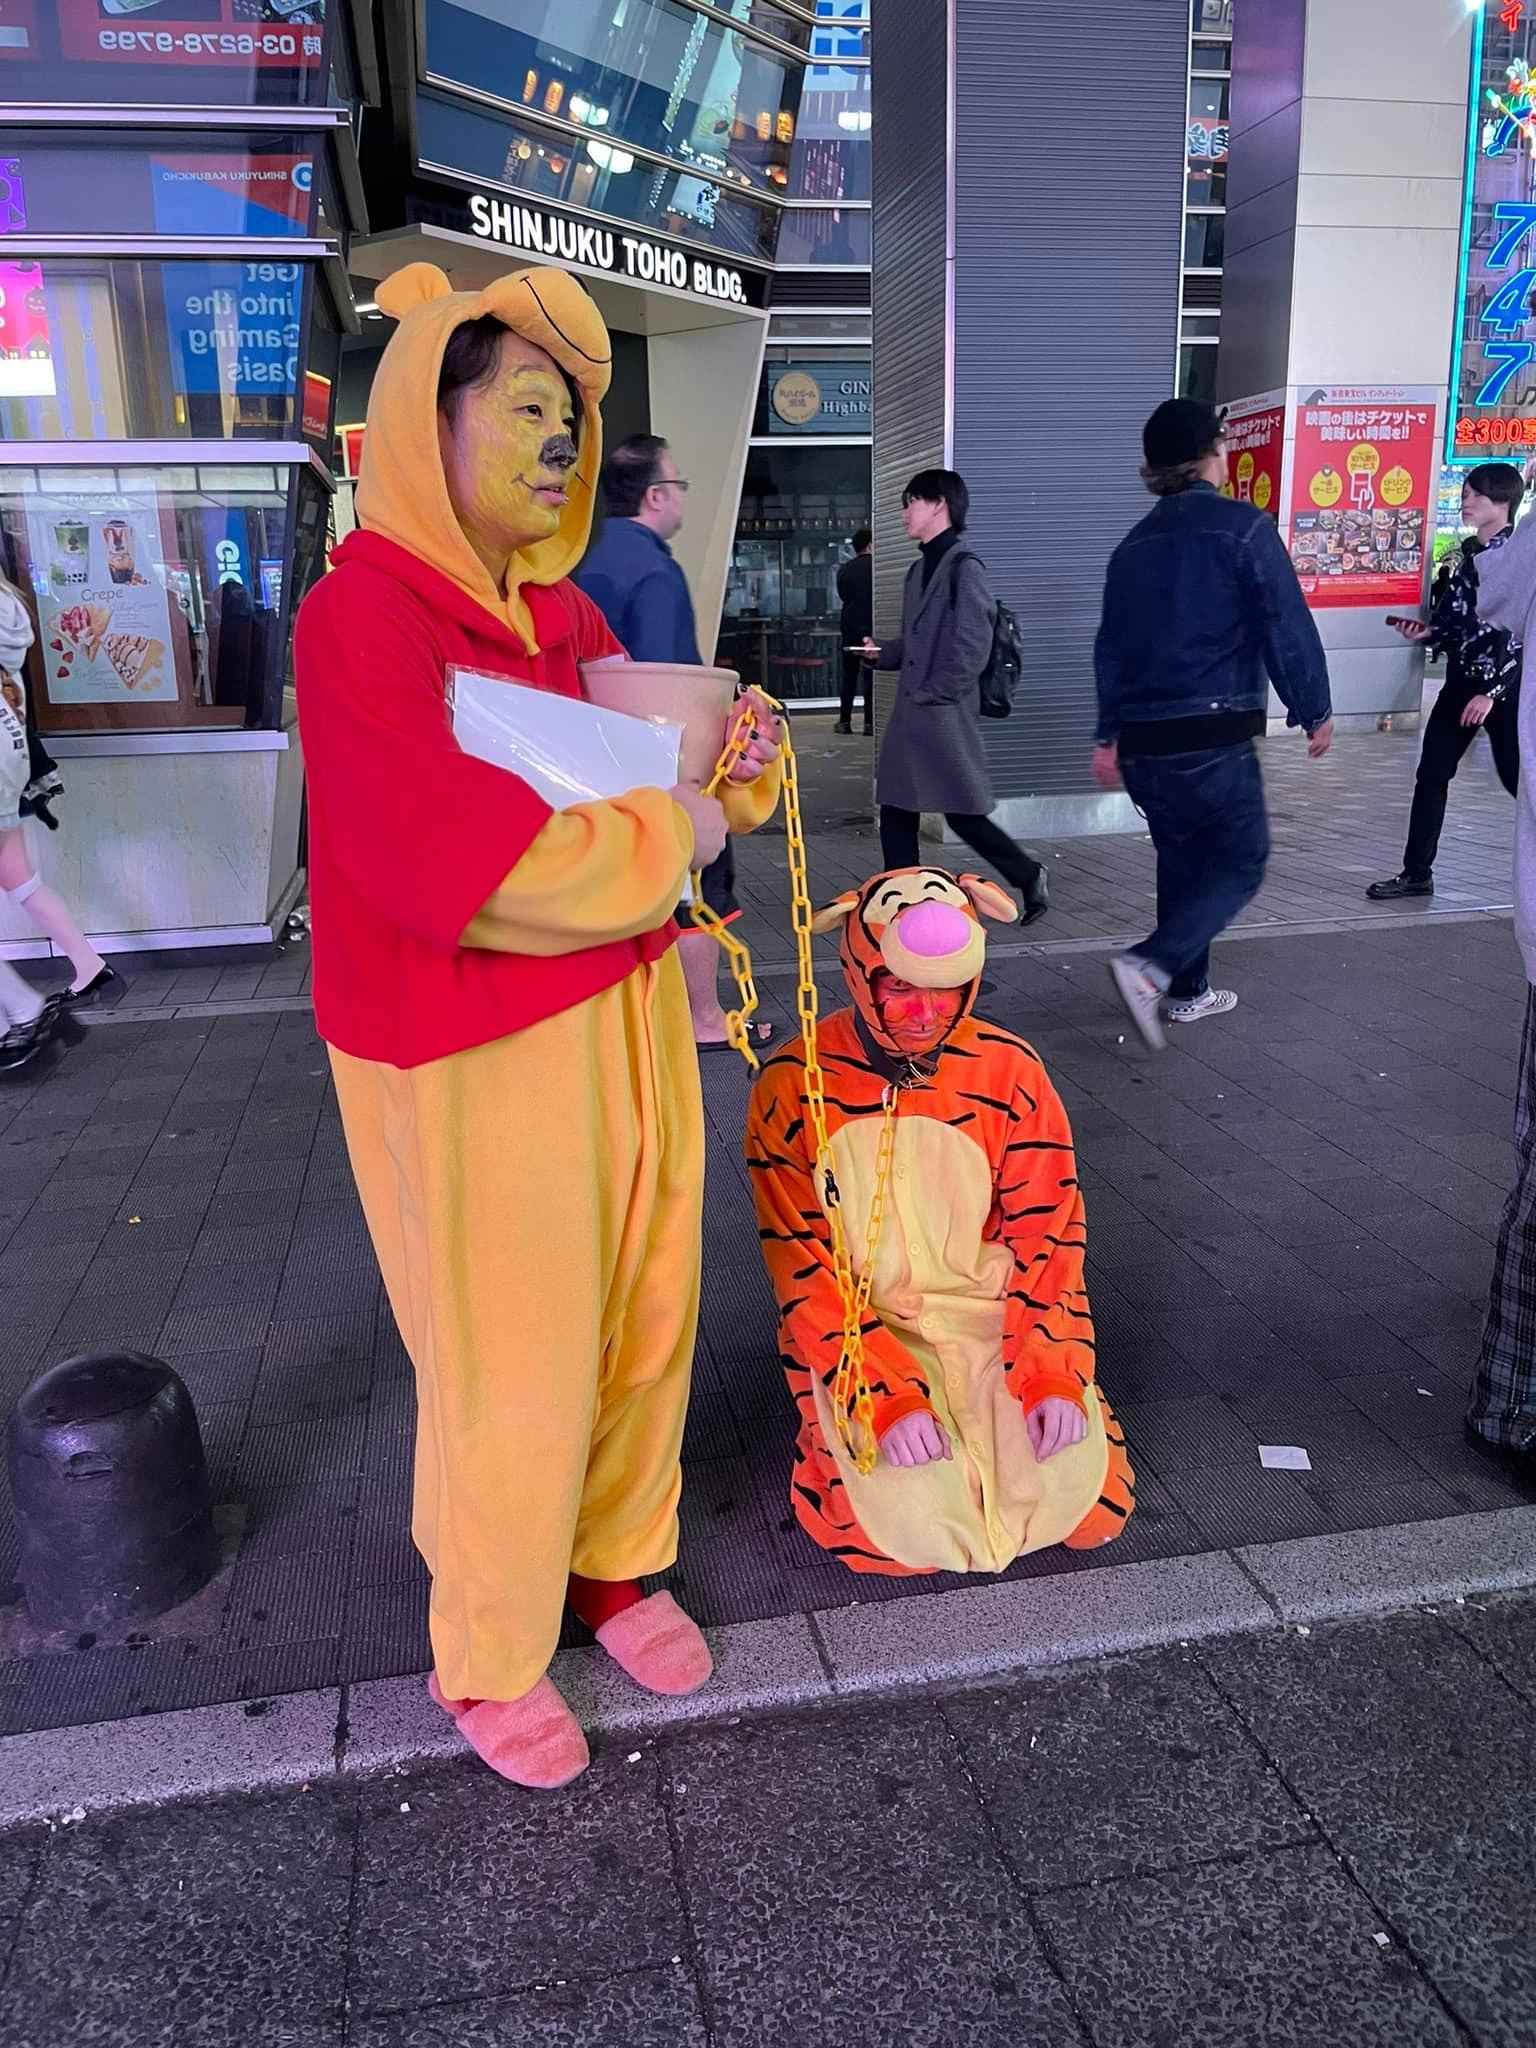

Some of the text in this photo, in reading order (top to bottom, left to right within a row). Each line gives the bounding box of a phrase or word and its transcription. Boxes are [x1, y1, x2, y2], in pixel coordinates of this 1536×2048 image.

[469, 195, 748, 304] SHINJUKU TOHO BLDG.
[81, 588, 124, 604] Crepe
